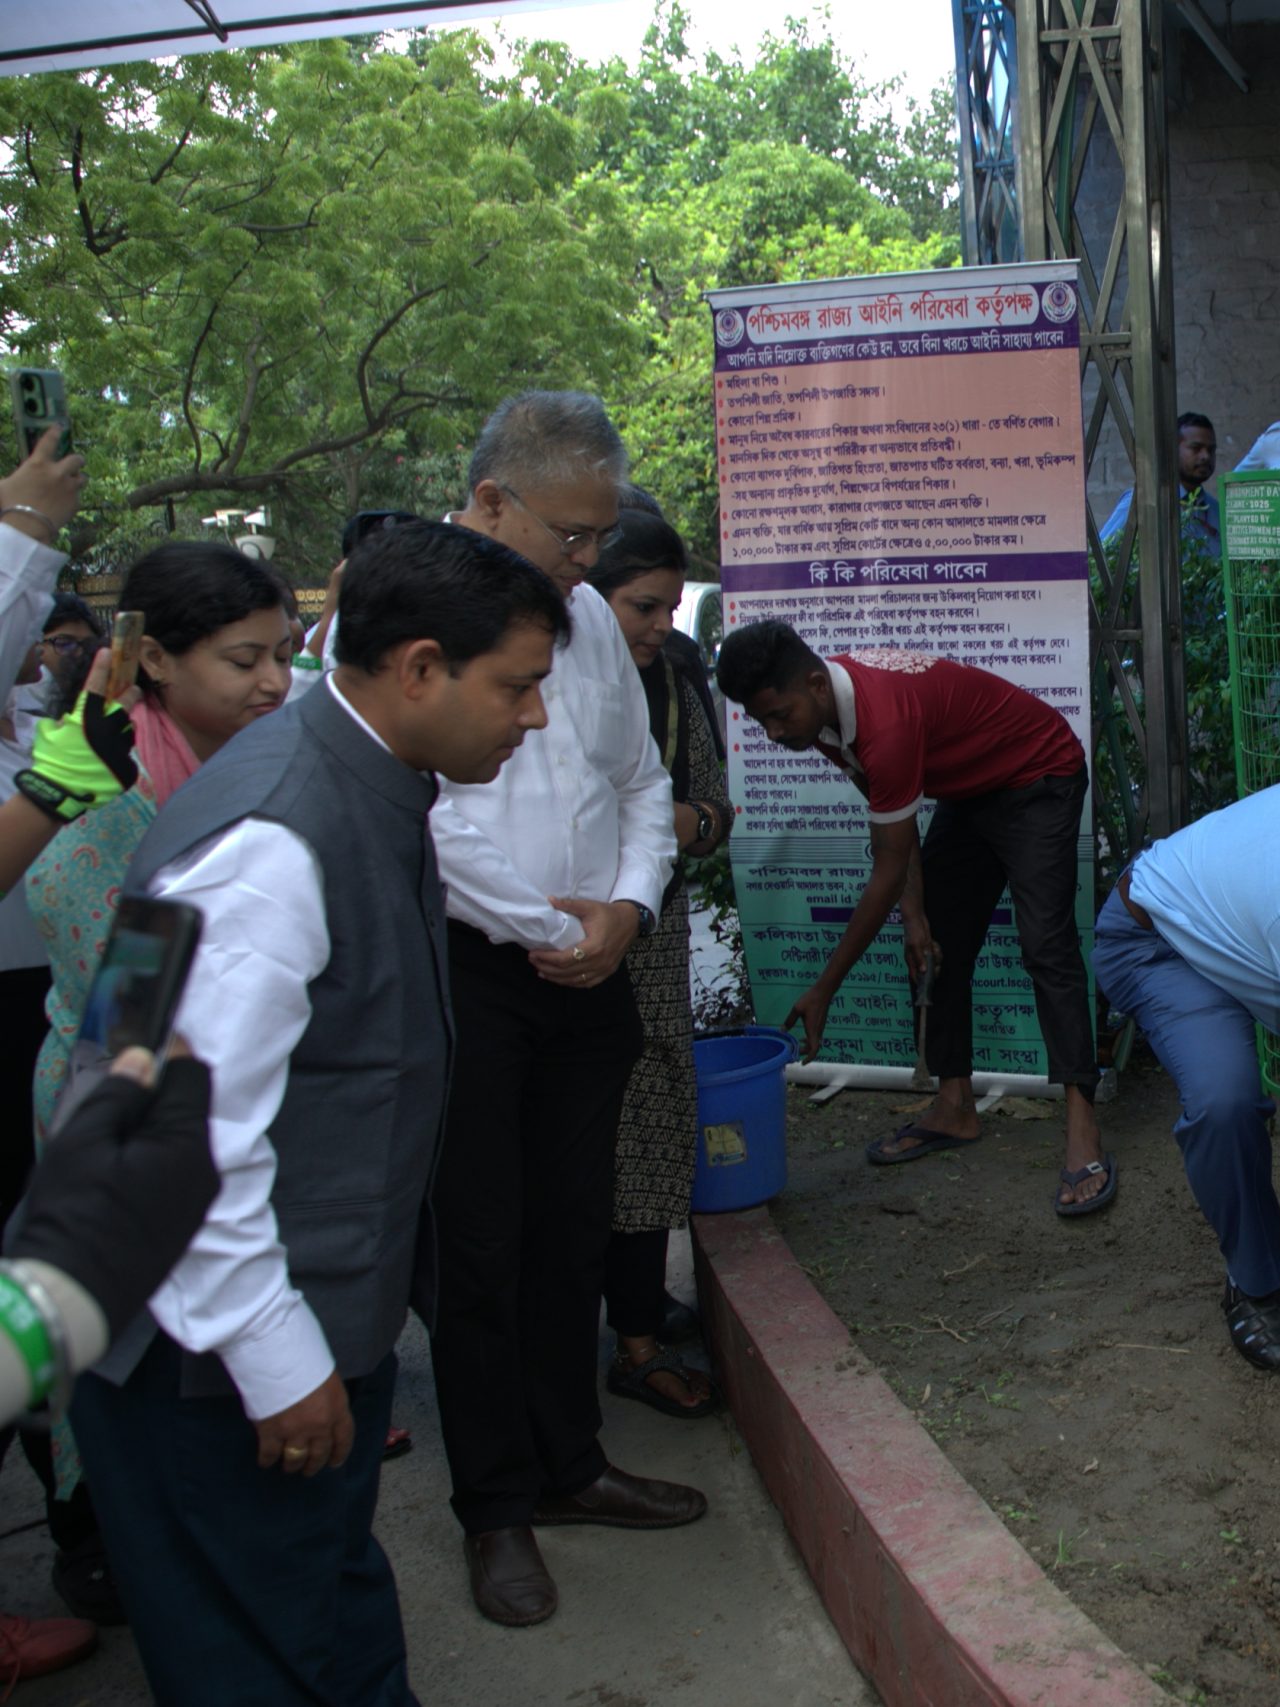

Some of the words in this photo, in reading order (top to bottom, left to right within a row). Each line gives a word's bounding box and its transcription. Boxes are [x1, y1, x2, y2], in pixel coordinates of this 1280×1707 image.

[748, 302, 810, 334] পশ্চিমবঙ্গ
[817, 306, 851, 328] রাজ্য
[859, 294, 902, 324] আইনি
[909, 290, 968, 320] পরিষেবা
[975, 285, 1032, 326] কর্তৃপক্ষ
[726, 347, 756, 366] আপনি
[757, 346, 772, 364] যদি
[856, 339, 877, 357] কেউ
[879, 340, 896, 355] হন,
[898, 339, 919, 354] তবে
[921, 336, 940, 352] বিনা
[942, 336, 968, 350] খরচে
[969, 331, 1000, 349] আইনি
[1034, 330, 1063, 345] পাবেন
[725, 374, 750, 388] মহিলা
[751, 376, 760, 386] বা
[760, 372, 778, 386] শিশু
[809, 562, 829, 583] কি
[832, 561, 855, 582] কি
[860, 559, 928, 580] পরিষেবা
[933, 562, 987, 579] পাবেন
[748, 865, 821, 878] পশ্চিমবঙ্গ
[828, 867, 865, 878] রাজ্য
[806, 894, 837, 903] email
[841, 894, 851, 903] id
[754, 927, 819, 943] কলিকাতা
[852, 994, 898, 1010] আইনি
